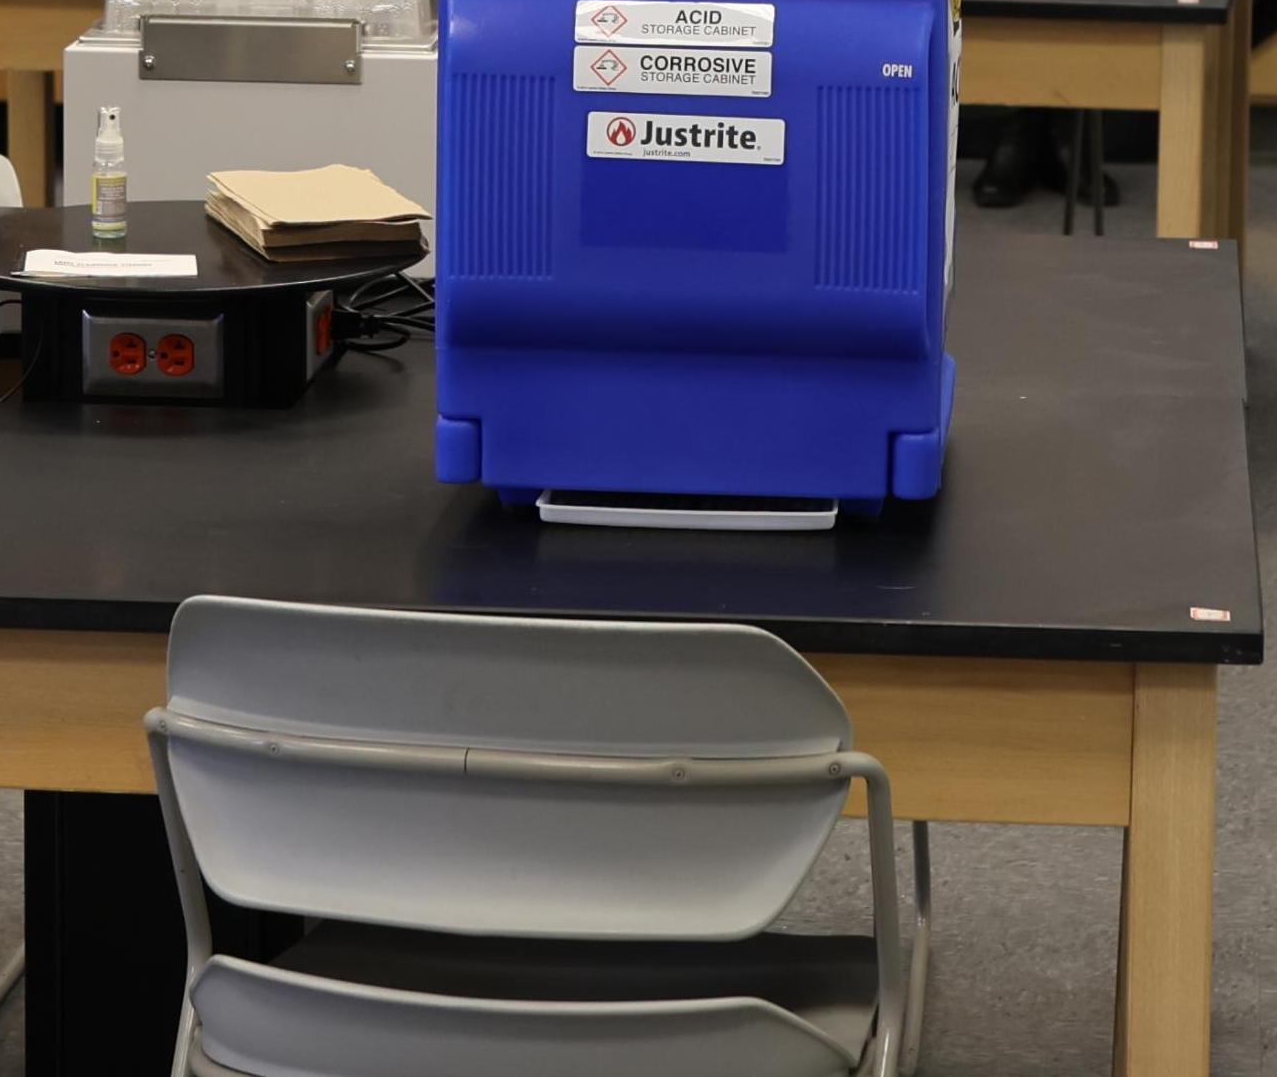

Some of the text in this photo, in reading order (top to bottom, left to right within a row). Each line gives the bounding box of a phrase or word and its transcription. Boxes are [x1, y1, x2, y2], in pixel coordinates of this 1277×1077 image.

[675, 9, 722, 25] ACID
[641, 24, 757, 37] STORAGE CABINET
[640, 54, 756, 74] CORROSIVE
[882, 63, 913, 78] OPEN
[640, 71, 756, 86] STORAGE CABINET
[640, 120, 757, 150] Justrite
[642, 149, 691, 158] justrite.com
